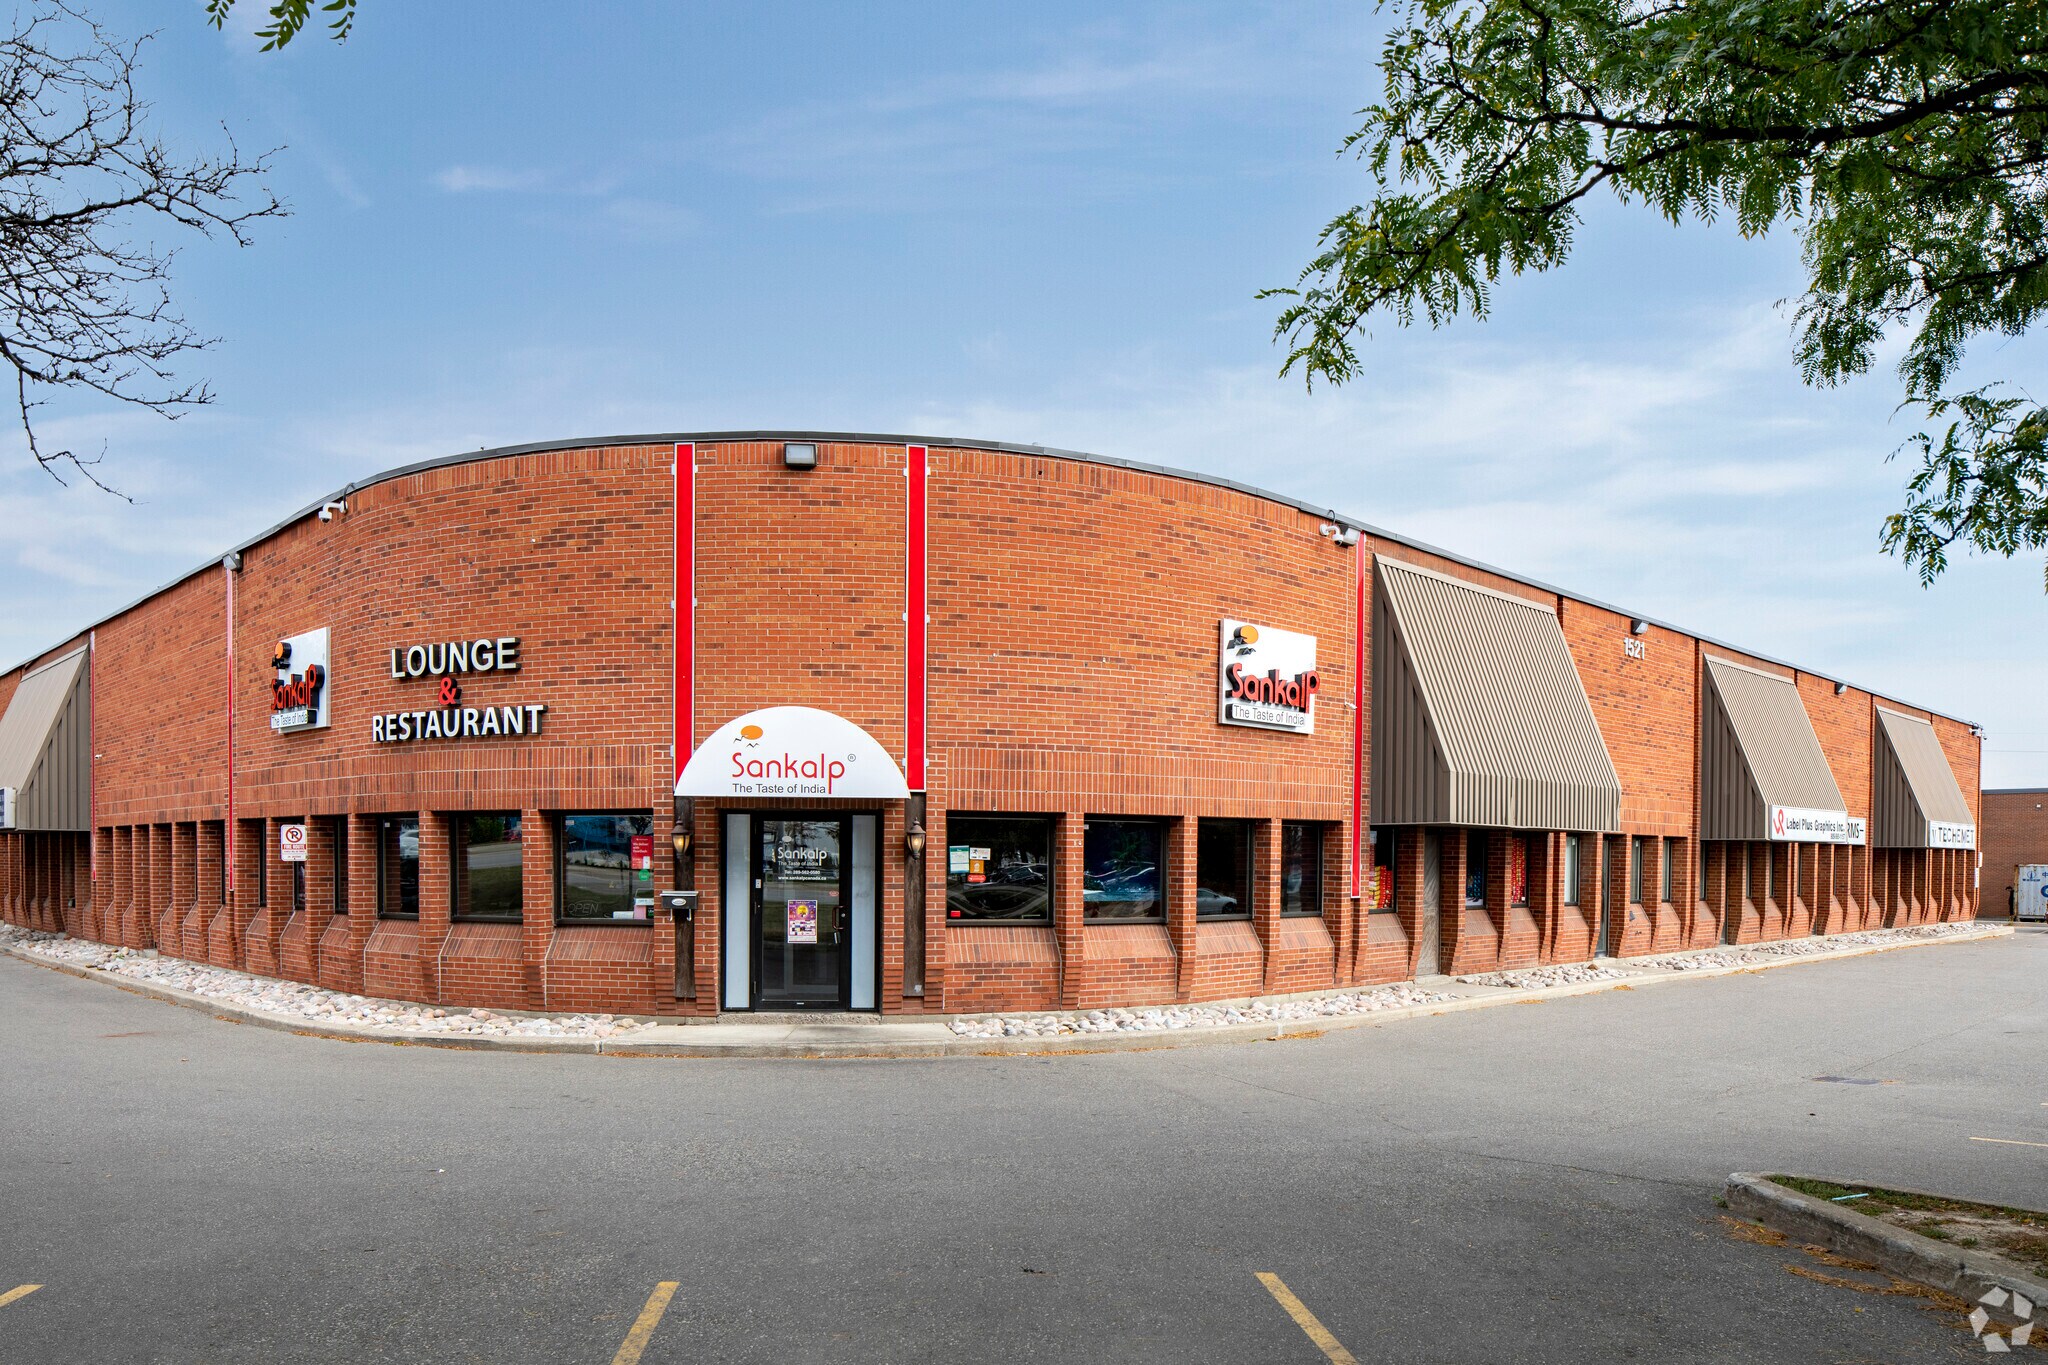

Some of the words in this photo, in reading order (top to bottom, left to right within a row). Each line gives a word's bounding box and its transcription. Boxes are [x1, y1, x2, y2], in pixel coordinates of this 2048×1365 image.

[391, 637, 520, 678] LOUNGE
[1623, 637, 1645, 660] 1521
[438, 677, 460, 705] &
[1230, 663, 1320, 713] Sankalp
[372, 704, 547, 742] RESTAURANT
[1234, 705, 1250, 717] The
[1253, 708, 1273, 722] Taste
[1275, 711, 1285, 722] of
[1286, 713, 1304, 725] India
[732, 752, 845, 794] Sankalp
[732, 783, 752, 793] The
[756, 784, 783, 793] Taste
[787, 784, 797, 793] of
[801, 784, 825, 793] India
[1786, 818, 1801, 830] Label
[1802, 819, 1813, 830] Plus
[1814, 819, 1835, 834] Graphics
[1938, 827, 1974, 843] TECHEMET
[778, 847, 827, 866] Sankalp
[568, 903, 599, 914] OPEN
